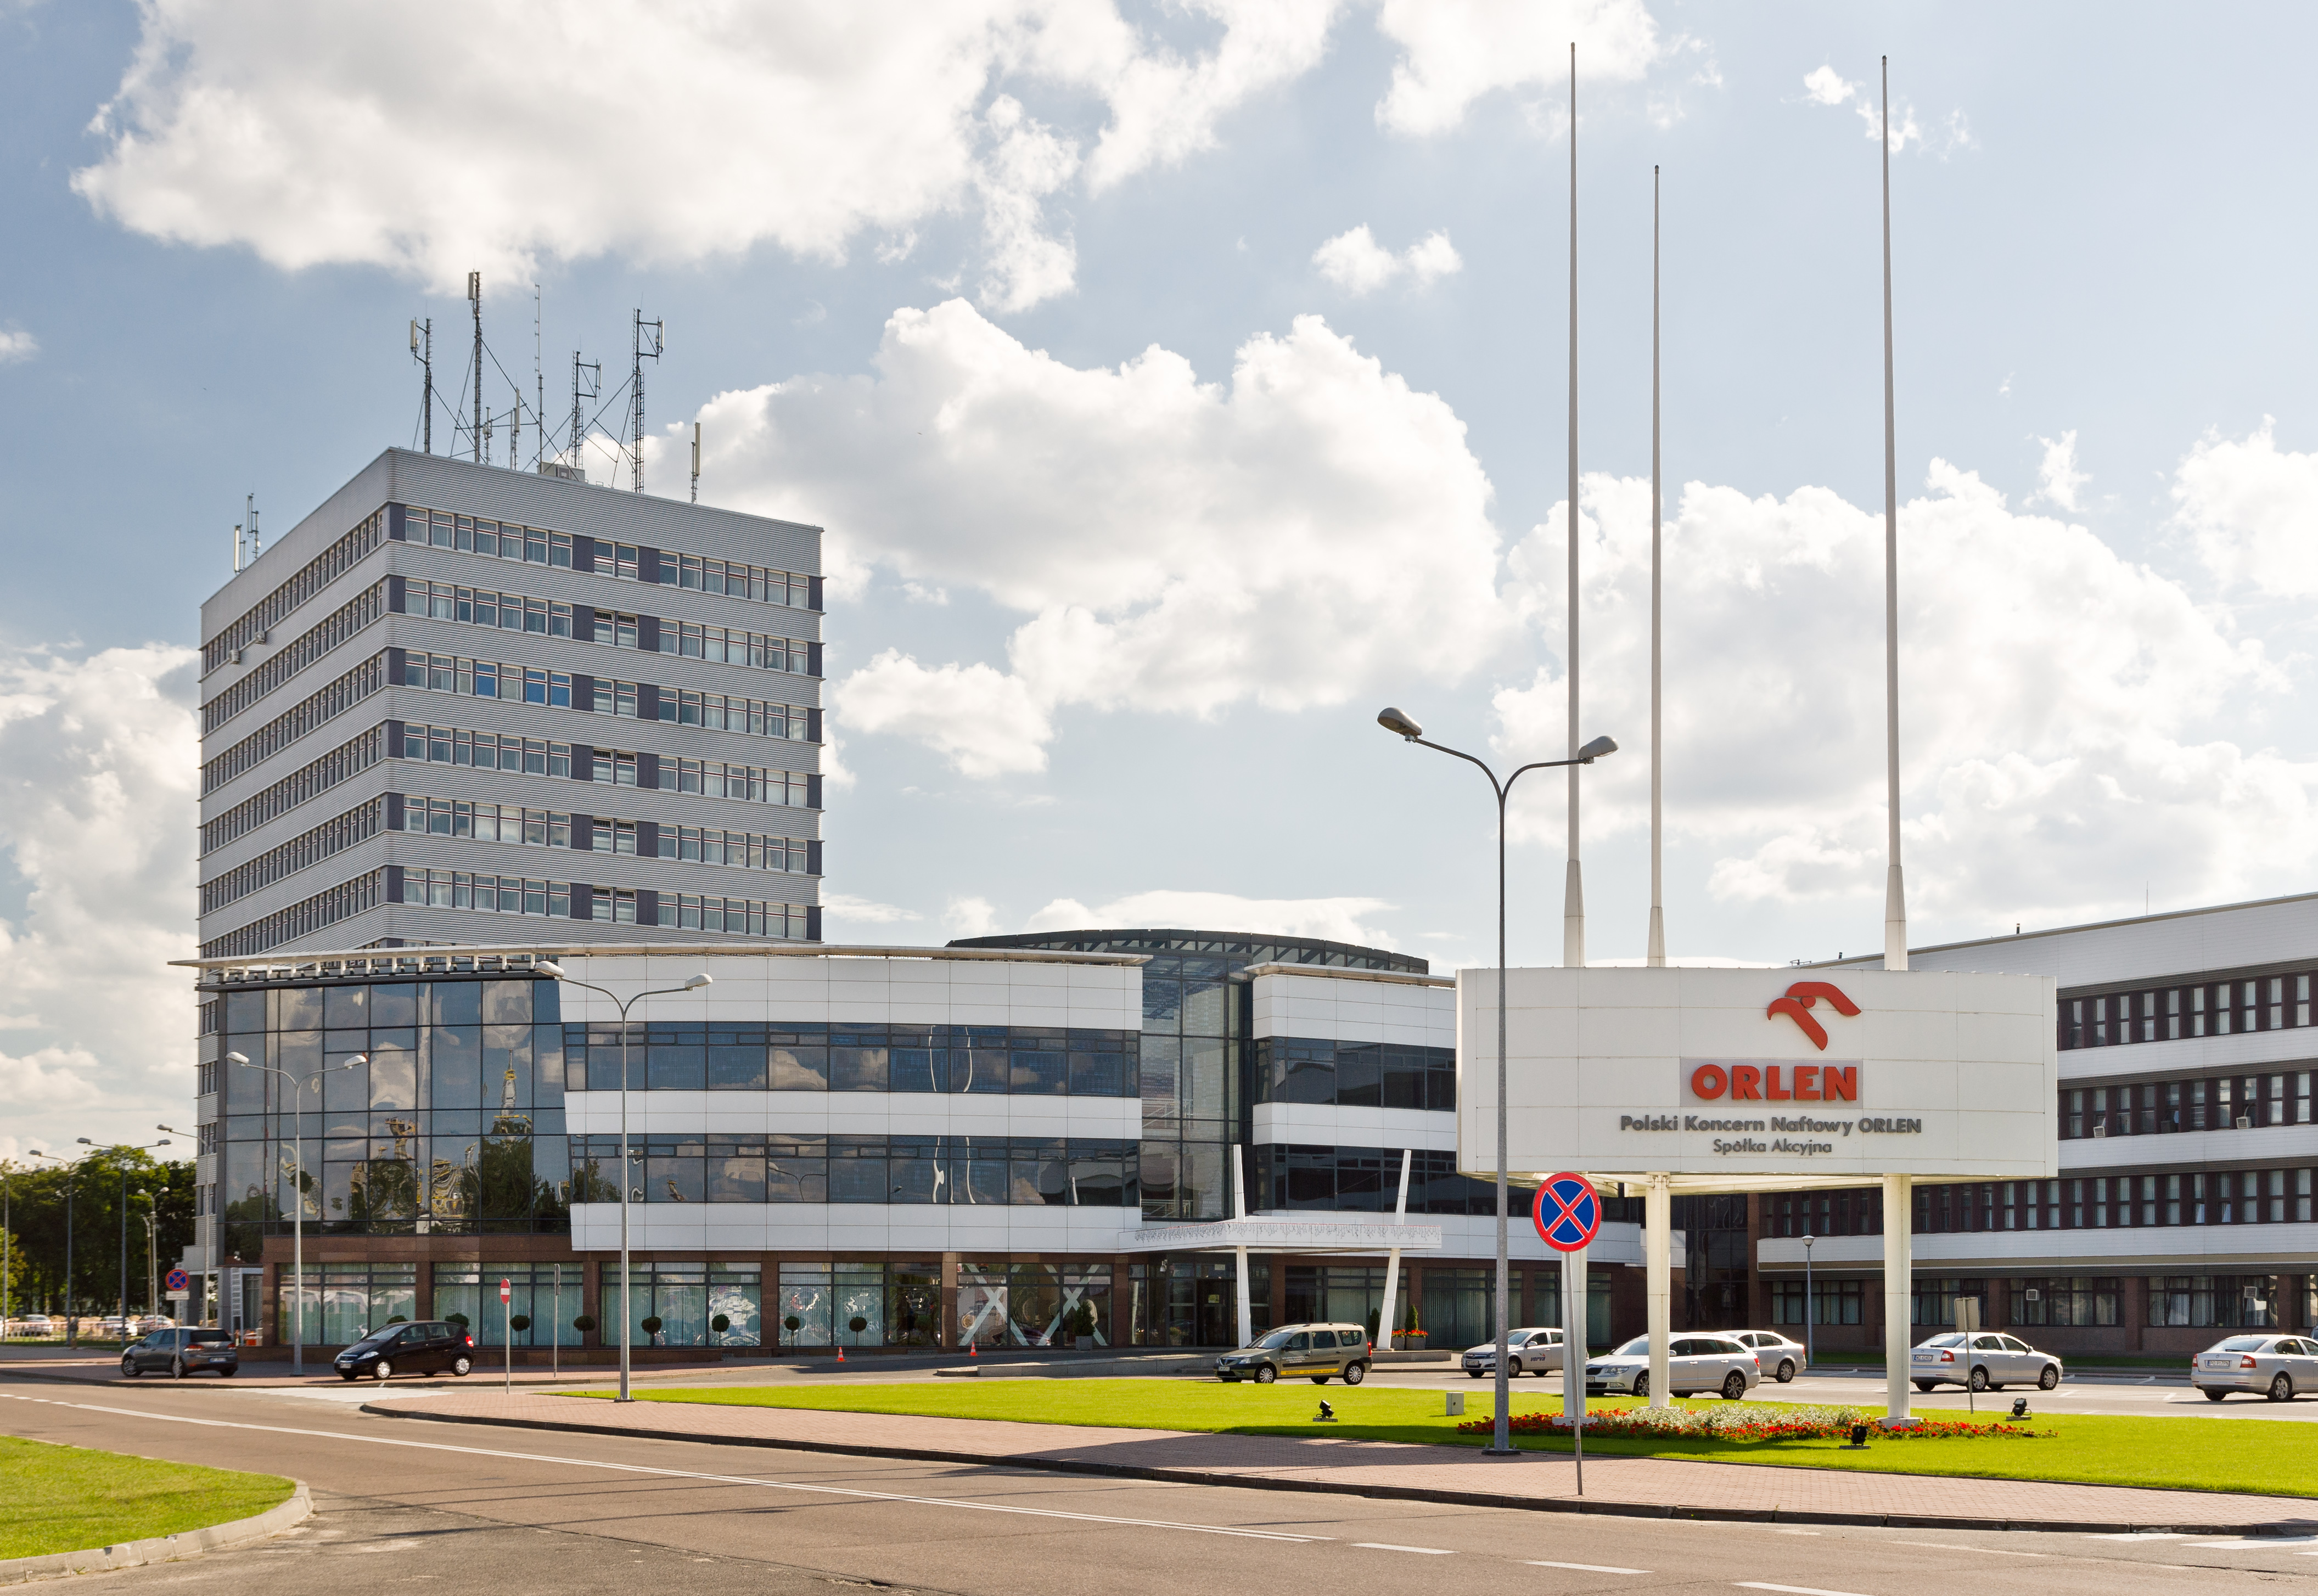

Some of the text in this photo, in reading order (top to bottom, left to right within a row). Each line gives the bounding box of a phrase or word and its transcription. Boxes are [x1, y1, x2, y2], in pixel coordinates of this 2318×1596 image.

[1691, 1064, 1857, 1100] ORLEN
[1621, 1115, 1921, 1136] Polski Koncern Naftowy ORLEN
[1713, 1138, 1832, 1156] Spółka Akcyjna
